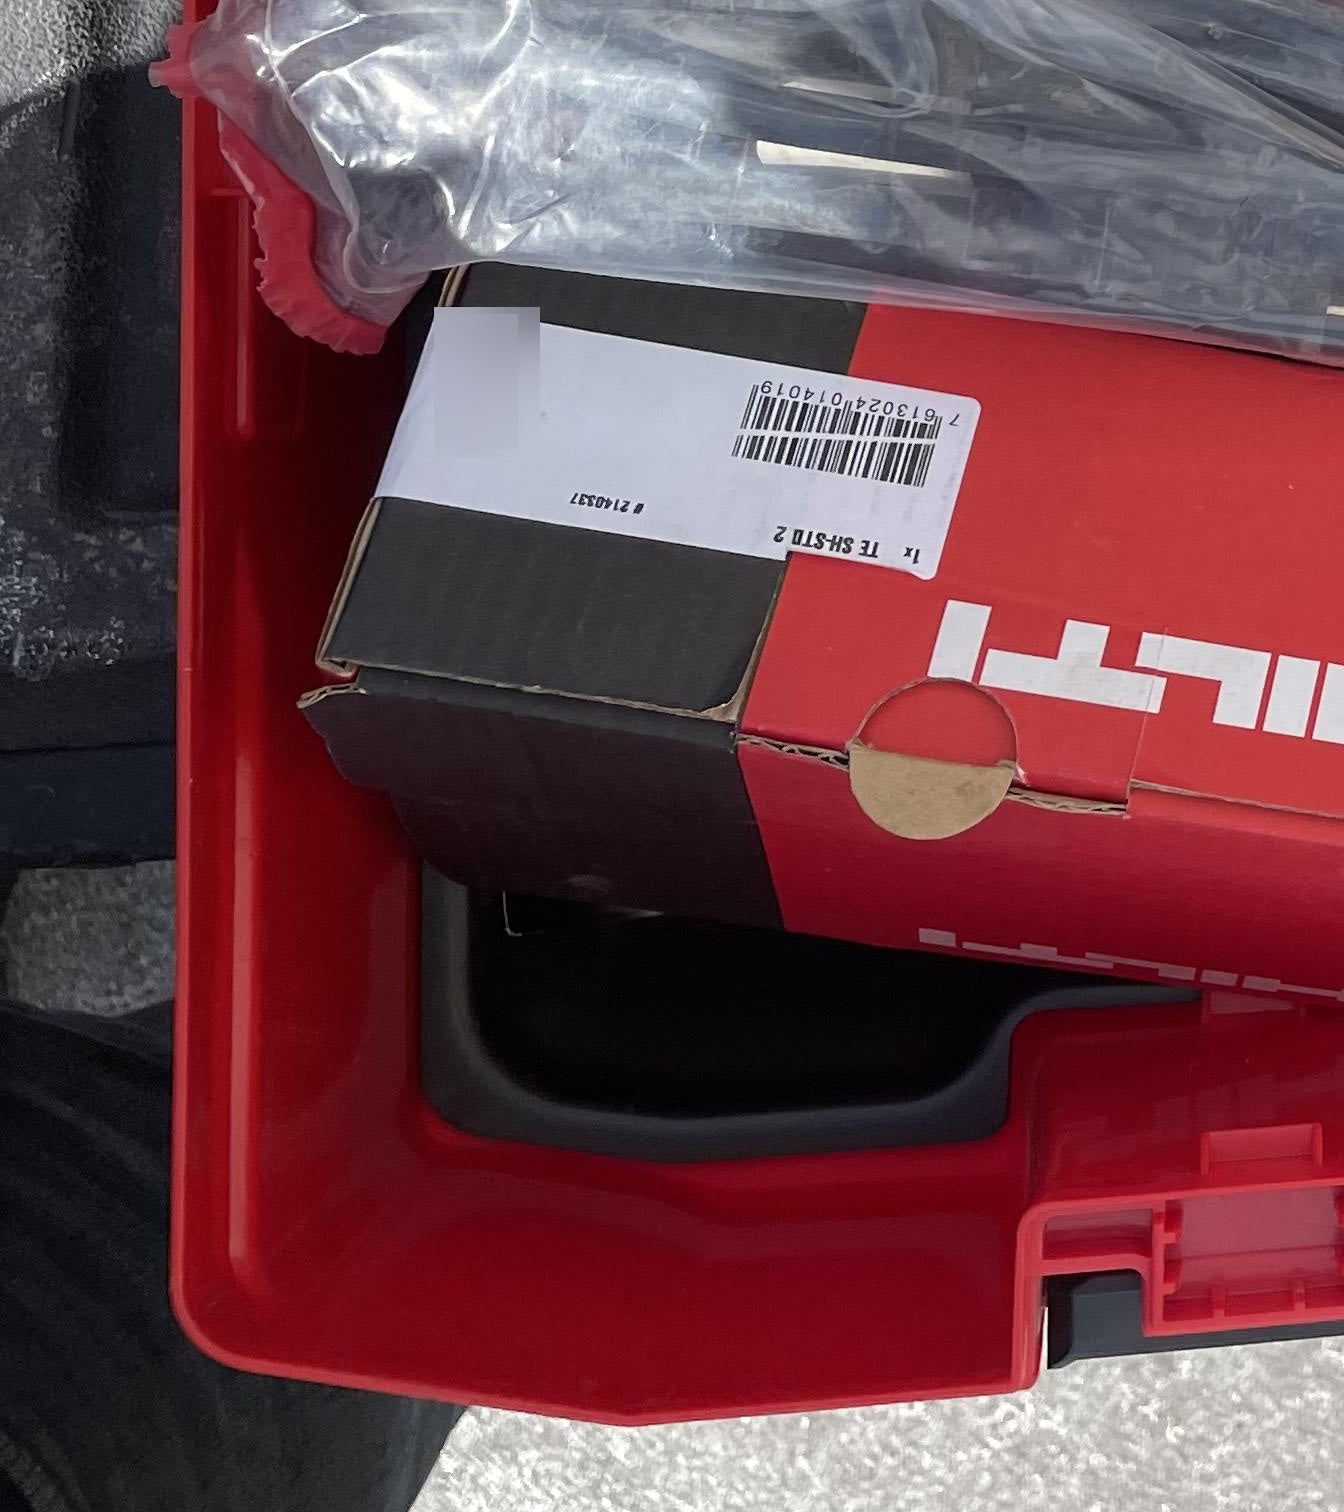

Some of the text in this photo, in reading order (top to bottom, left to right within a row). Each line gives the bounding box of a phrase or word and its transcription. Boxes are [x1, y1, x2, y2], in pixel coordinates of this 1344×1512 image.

[761, 380, 960, 426] 7 613024 014019
[773, 525, 920, 564] 1x TE SH-STD 2
